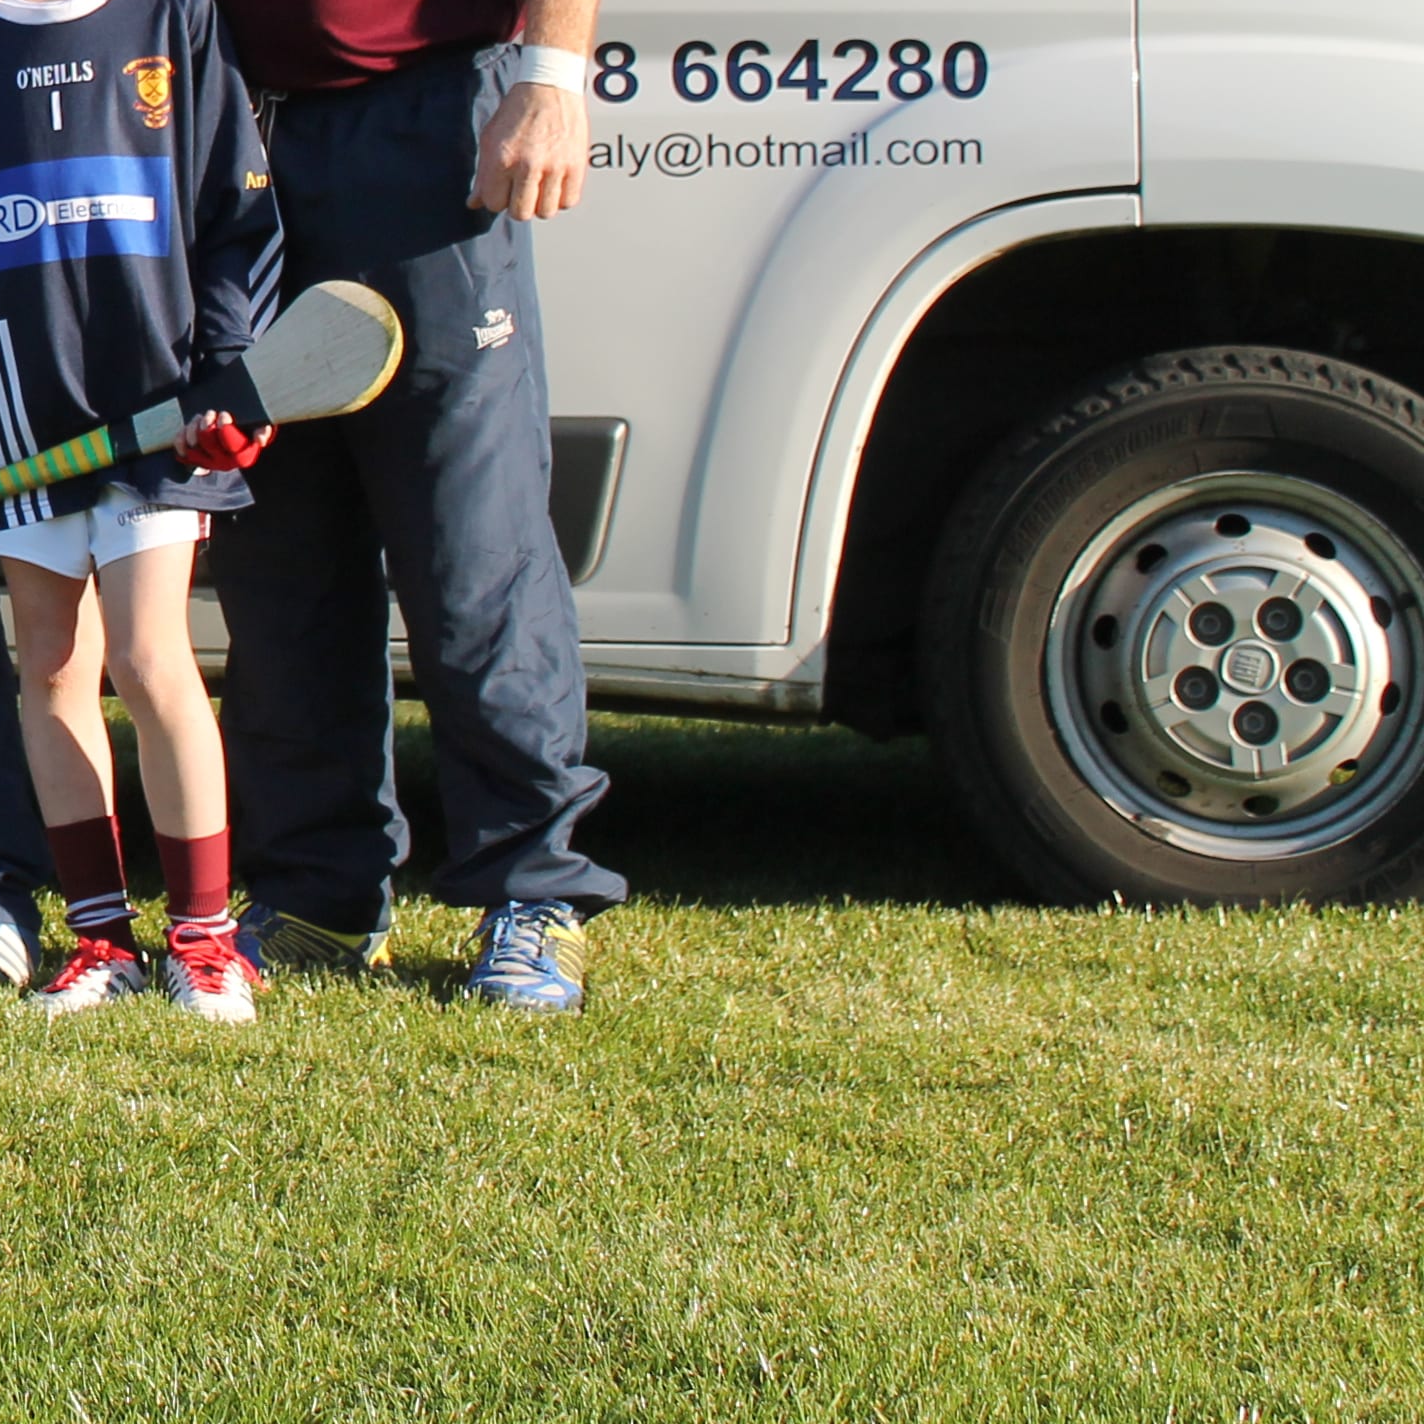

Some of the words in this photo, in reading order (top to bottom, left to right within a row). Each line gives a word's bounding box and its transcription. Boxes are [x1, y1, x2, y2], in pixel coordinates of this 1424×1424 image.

[16, 59, 95, 90] O'NEILLS
[593, 40, 639, 103] 8
[671, 38, 988, 103] 664280
[588, 131, 984, 178] aly@hotmail.com
